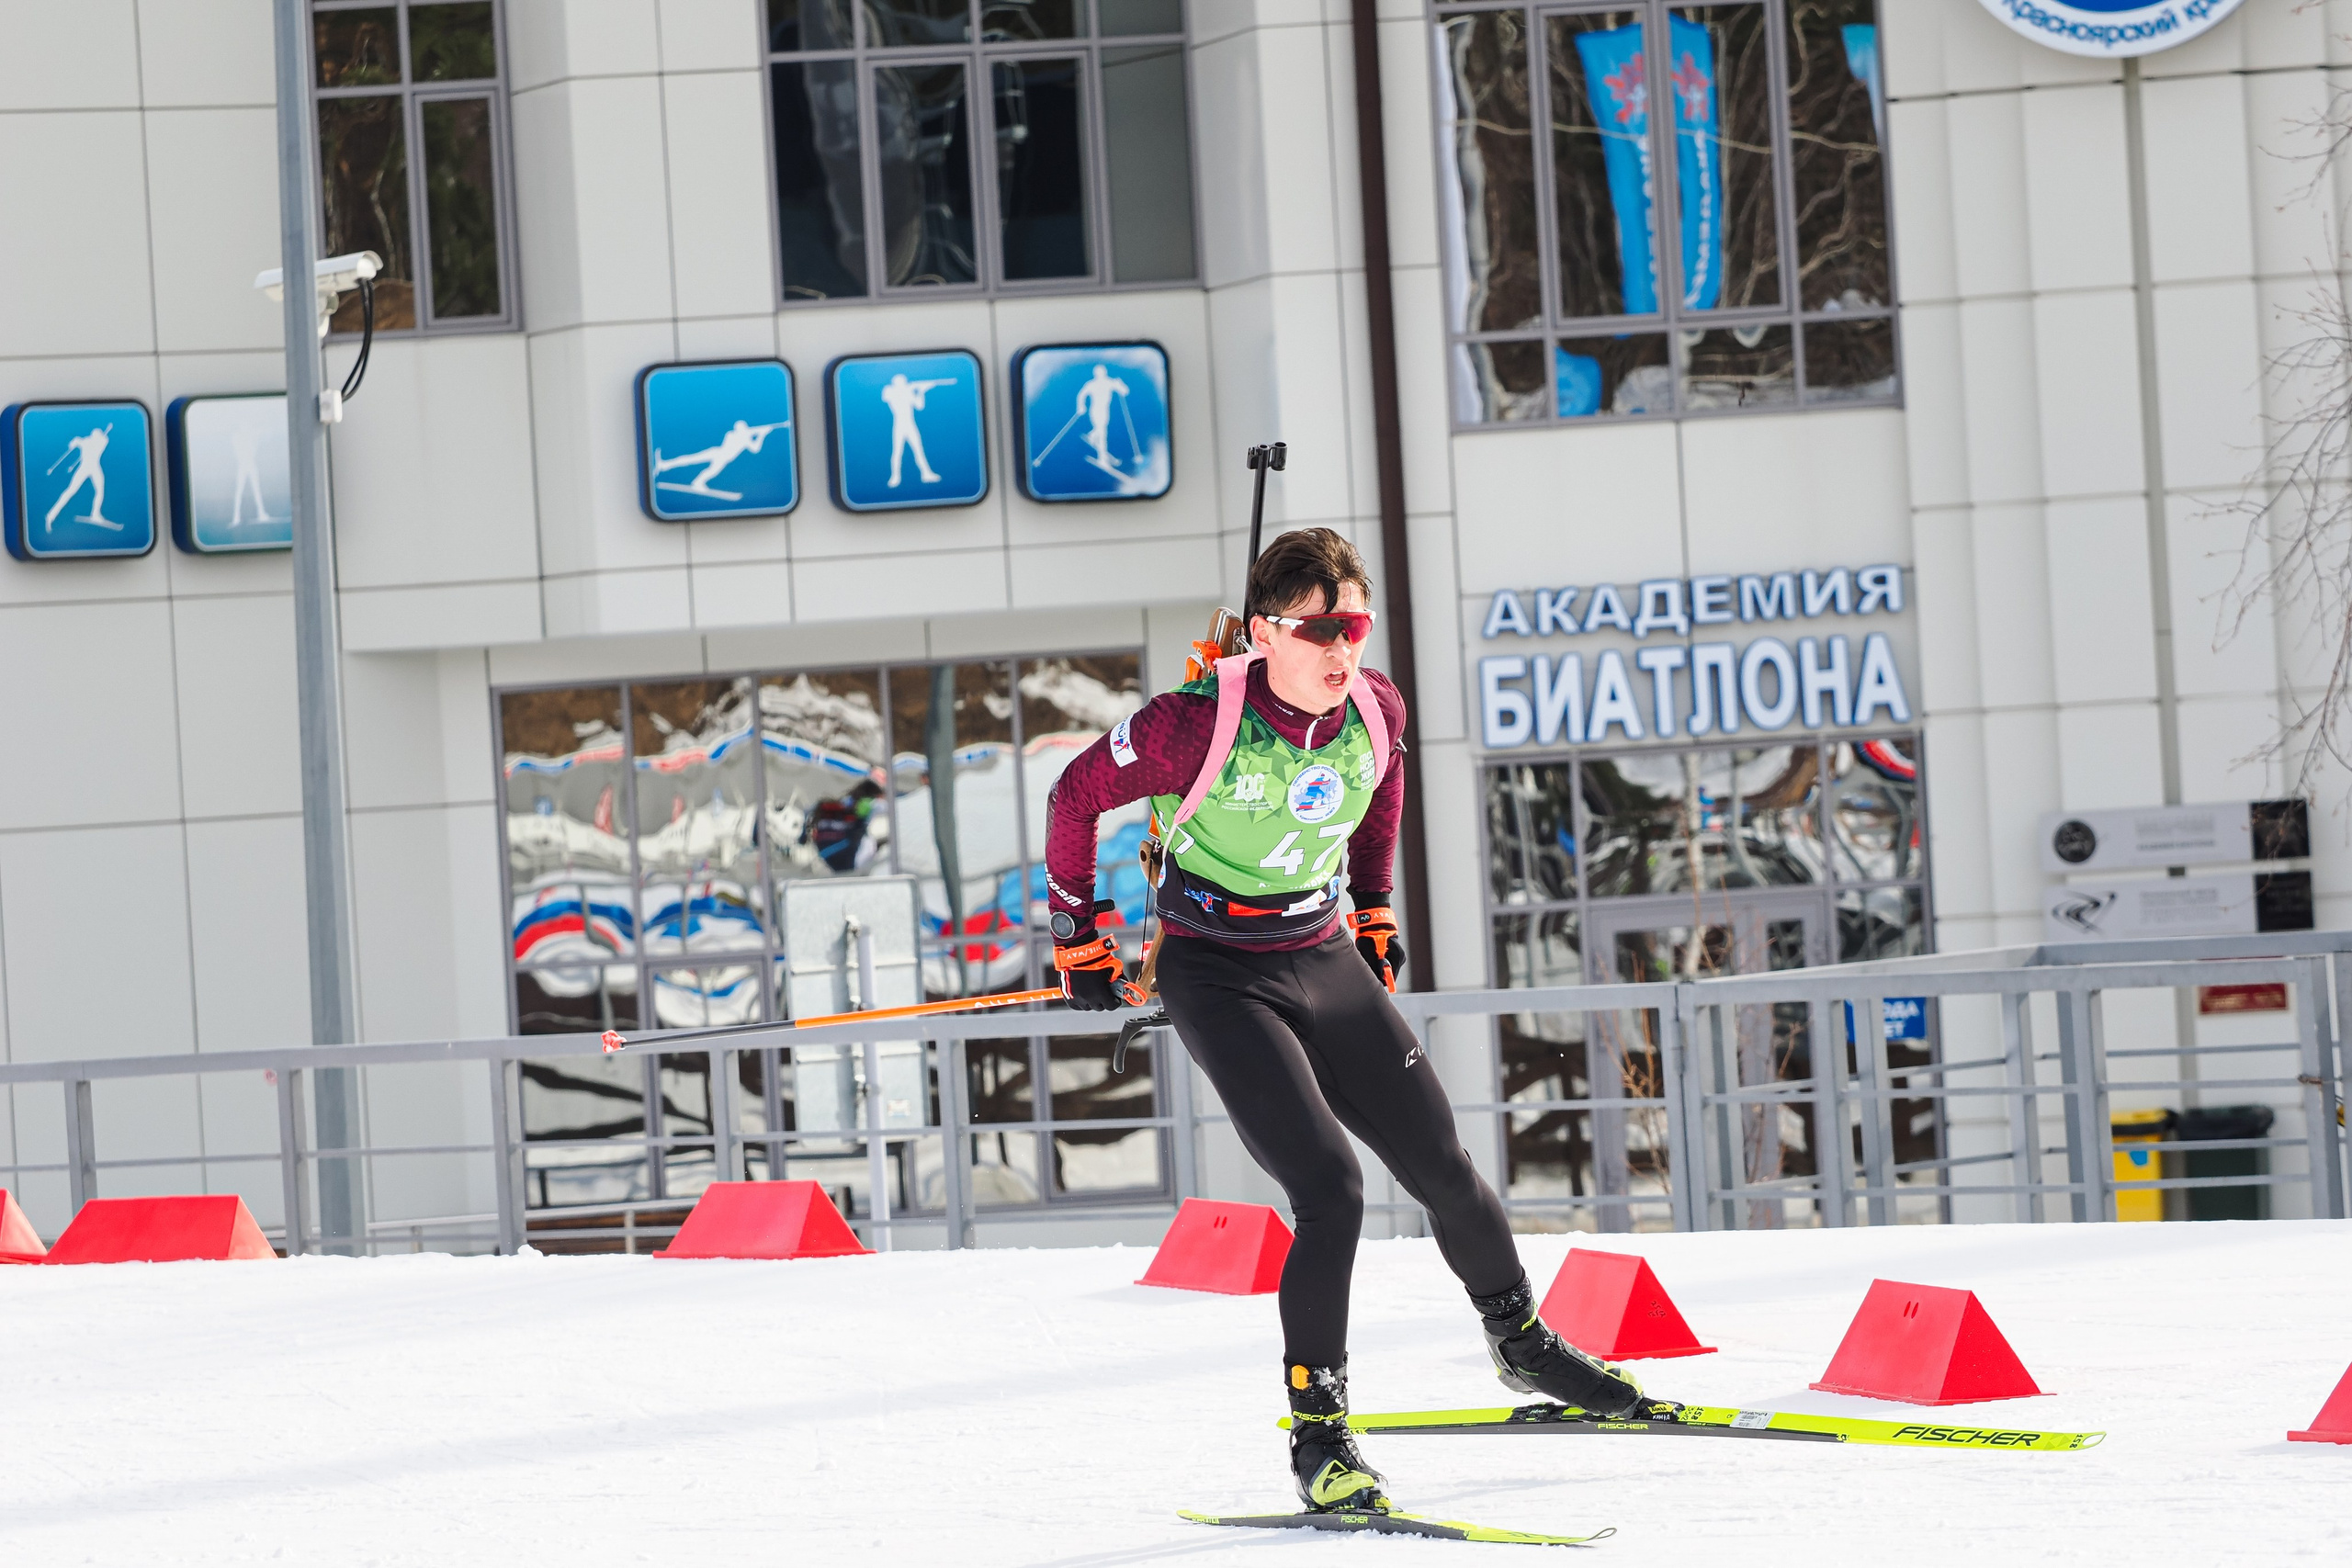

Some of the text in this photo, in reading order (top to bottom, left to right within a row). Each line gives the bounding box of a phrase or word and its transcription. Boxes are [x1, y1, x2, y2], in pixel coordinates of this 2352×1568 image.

[1482, 564, 1905, 639] АКАДЕМИЯ
[1478, 632, 1911, 749] БИАТЛОНА
[1259, 819, 1355, 876] 47
[1293, 1410, 1346, 1422] FISCHER
[1892, 1426, 2041, 1447] FISCHER
[1340, 1516, 1369, 1525] FISCHER
